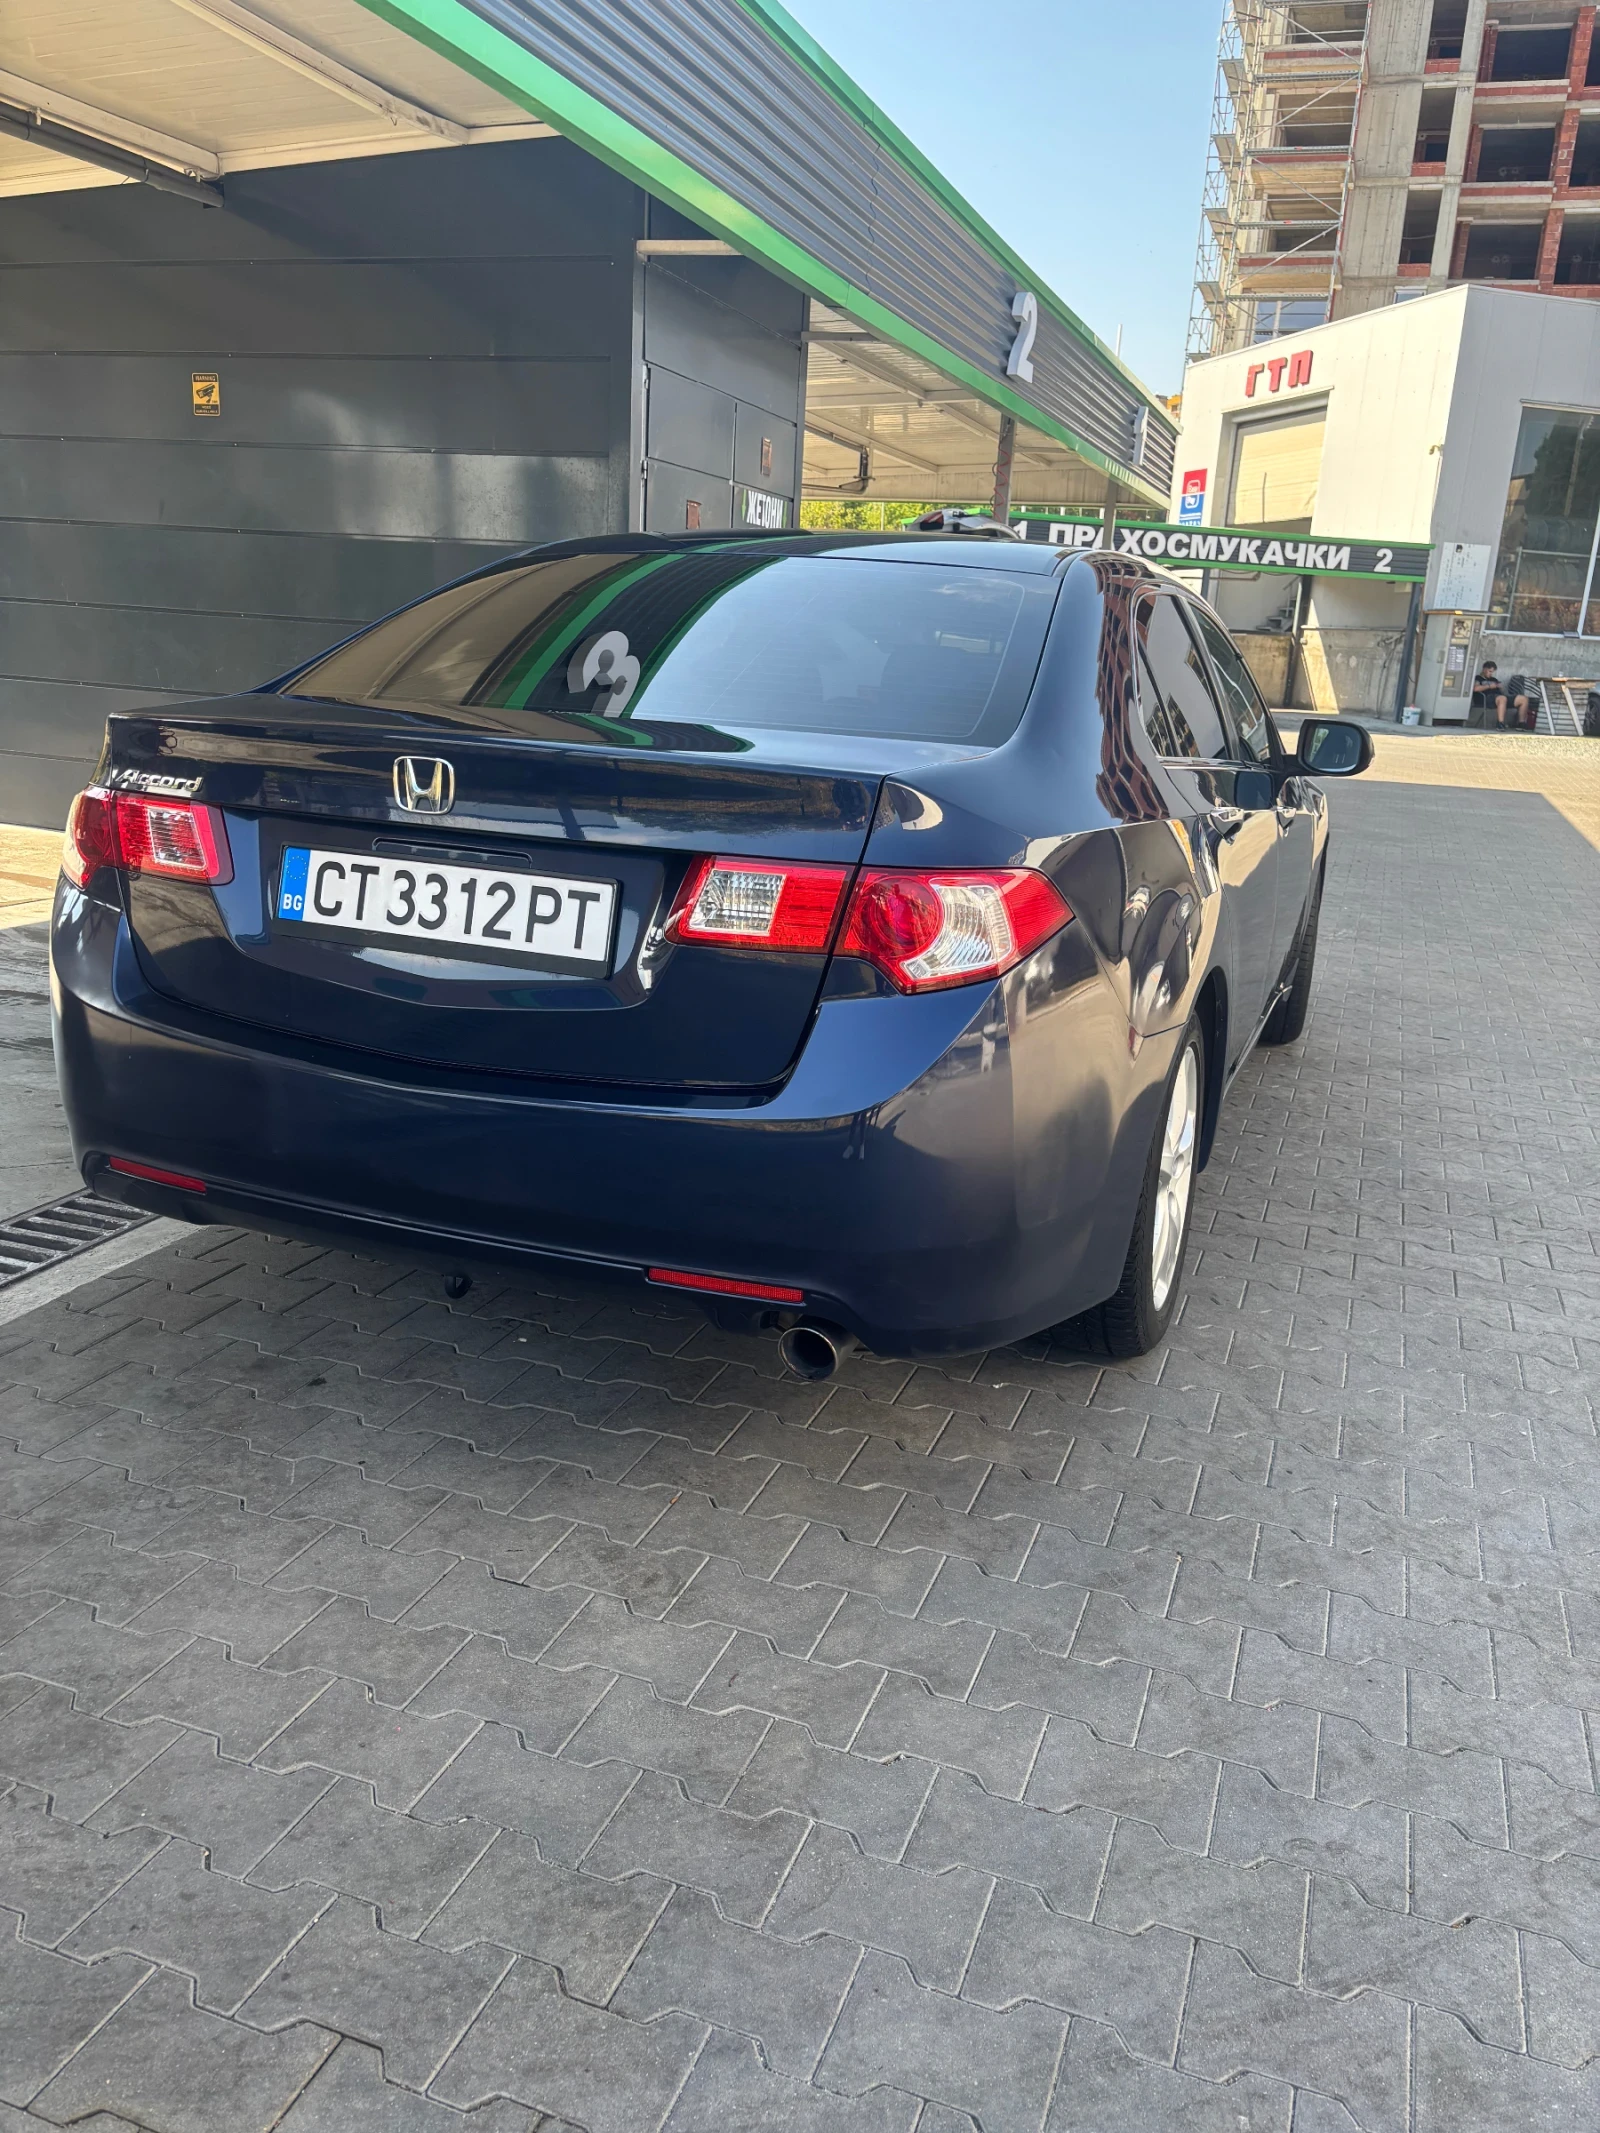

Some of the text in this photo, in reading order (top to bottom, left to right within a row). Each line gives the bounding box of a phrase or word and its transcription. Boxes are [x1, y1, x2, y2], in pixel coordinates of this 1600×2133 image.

[1006, 291, 1038, 384] 2
[1245, 349, 1314, 398] ГТП
[746, 490, 784, 528] ЖЕТОНИ
[1374, 548, 1393, 573] 2
[115, 768, 203, 792] Accord
[283, 894, 303, 912] BG
